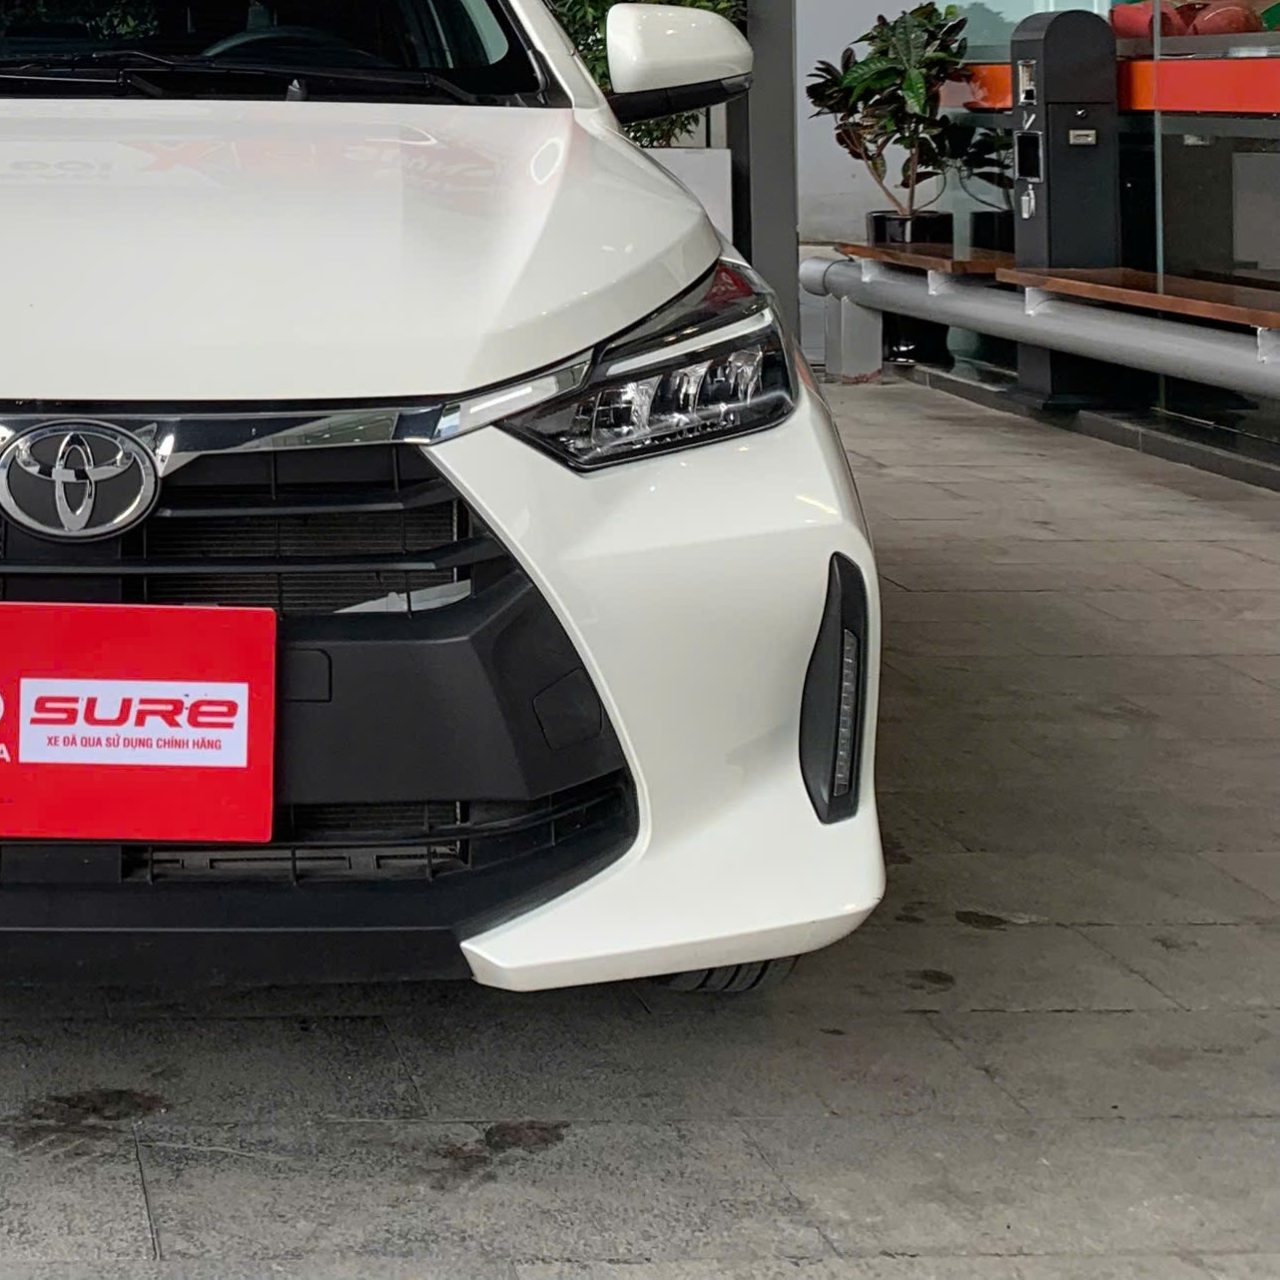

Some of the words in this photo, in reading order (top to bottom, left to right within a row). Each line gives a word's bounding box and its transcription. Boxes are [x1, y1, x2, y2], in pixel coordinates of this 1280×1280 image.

[47, 736, 60, 747] XE
[63, 734, 77, 747] ĐÃ
[80, 736, 102, 748] QUA
[105, 734, 120, 748] SỬ
[123, 737, 153, 751] DỤNG
[156, 736, 189, 749] CHÍNH
[192, 737, 222, 750] HÃNG
